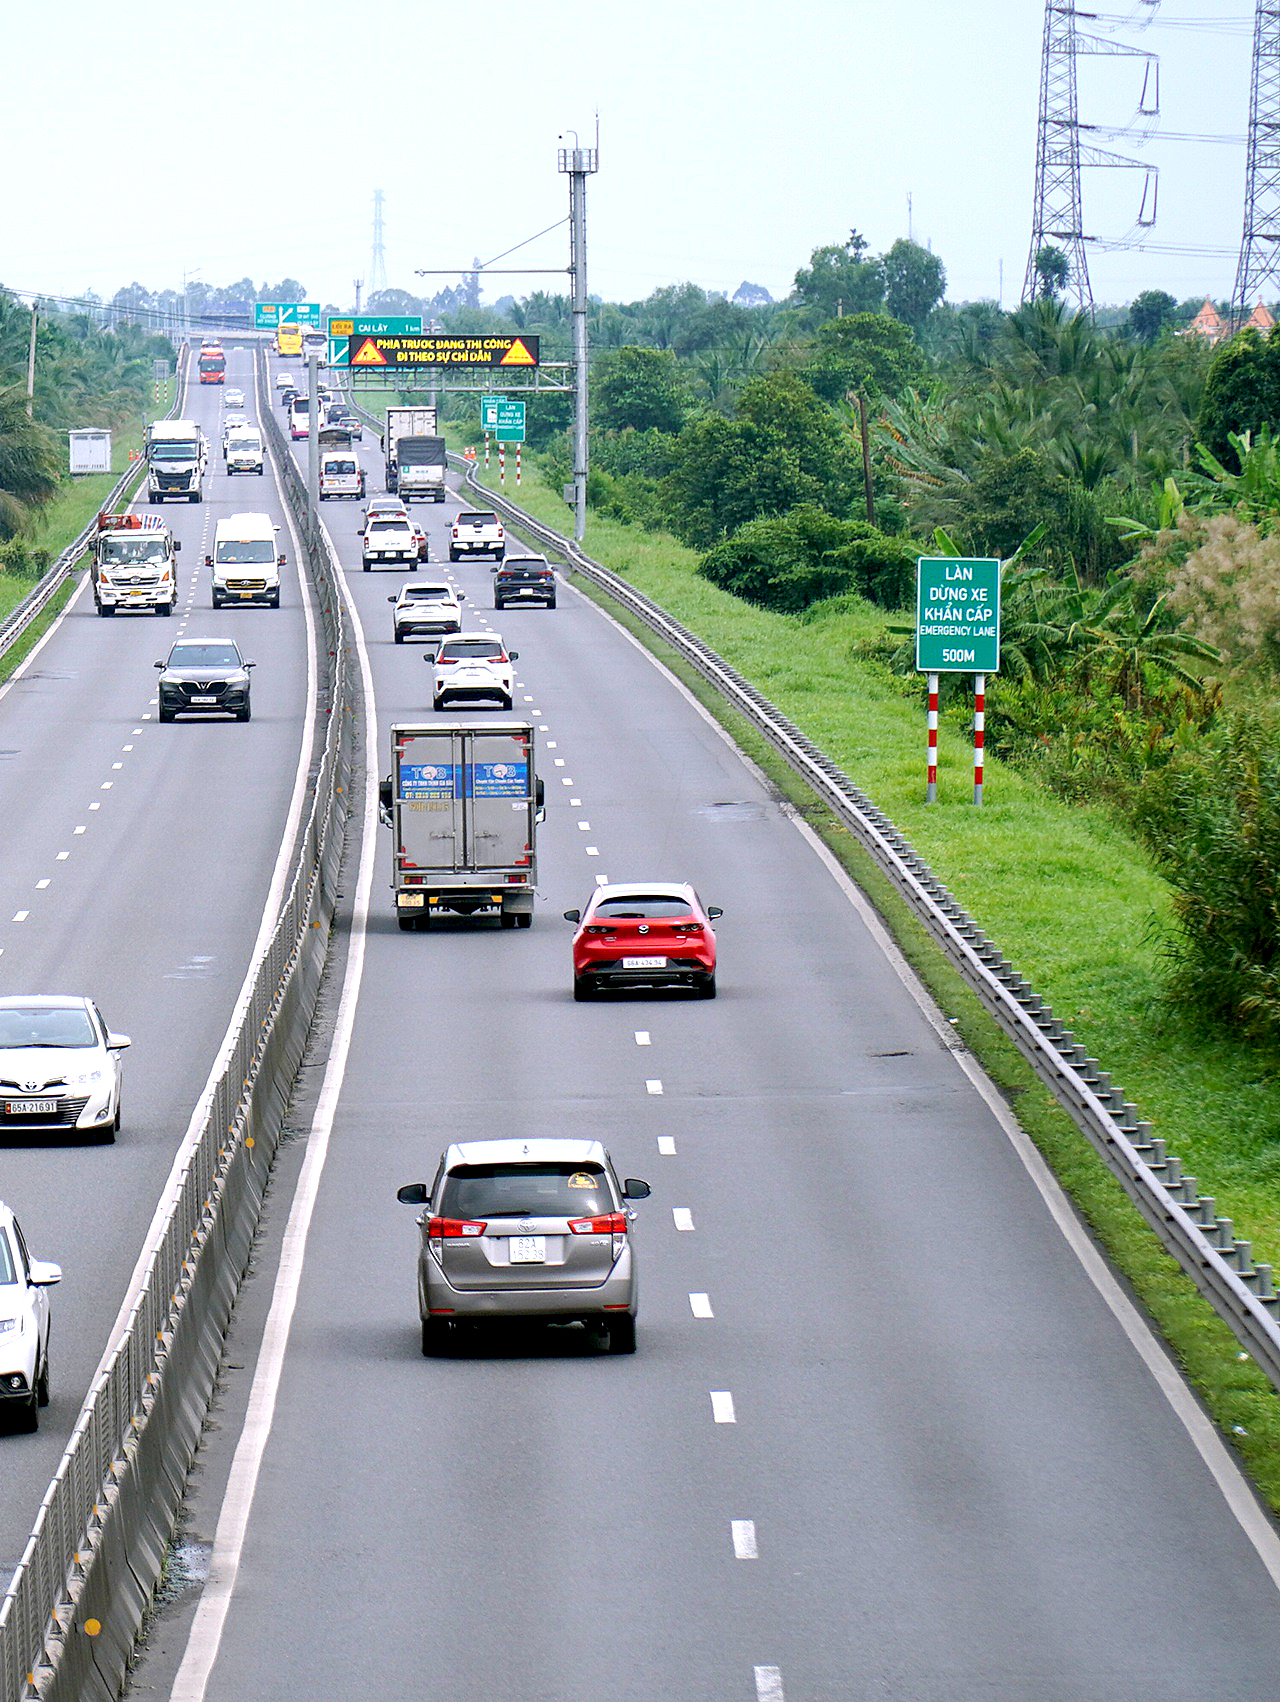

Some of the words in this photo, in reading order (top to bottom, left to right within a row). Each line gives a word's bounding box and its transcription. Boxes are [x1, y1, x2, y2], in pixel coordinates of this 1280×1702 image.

[466, 340, 482, 349] THI
[396, 352, 408, 361] ĐI
[409, 352, 435, 361] THEO
[945, 564, 972, 580] LÀN
[930, 584, 968, 600] DỪNG
[971, 588, 988, 601] XE
[924, 602, 962, 620] KHẨN
[966, 604, 993, 621] CẤP
[920, 625, 971, 635] EMERGENCY
[973, 626, 996, 636] LANE
[942, 649, 975, 662] 500M
